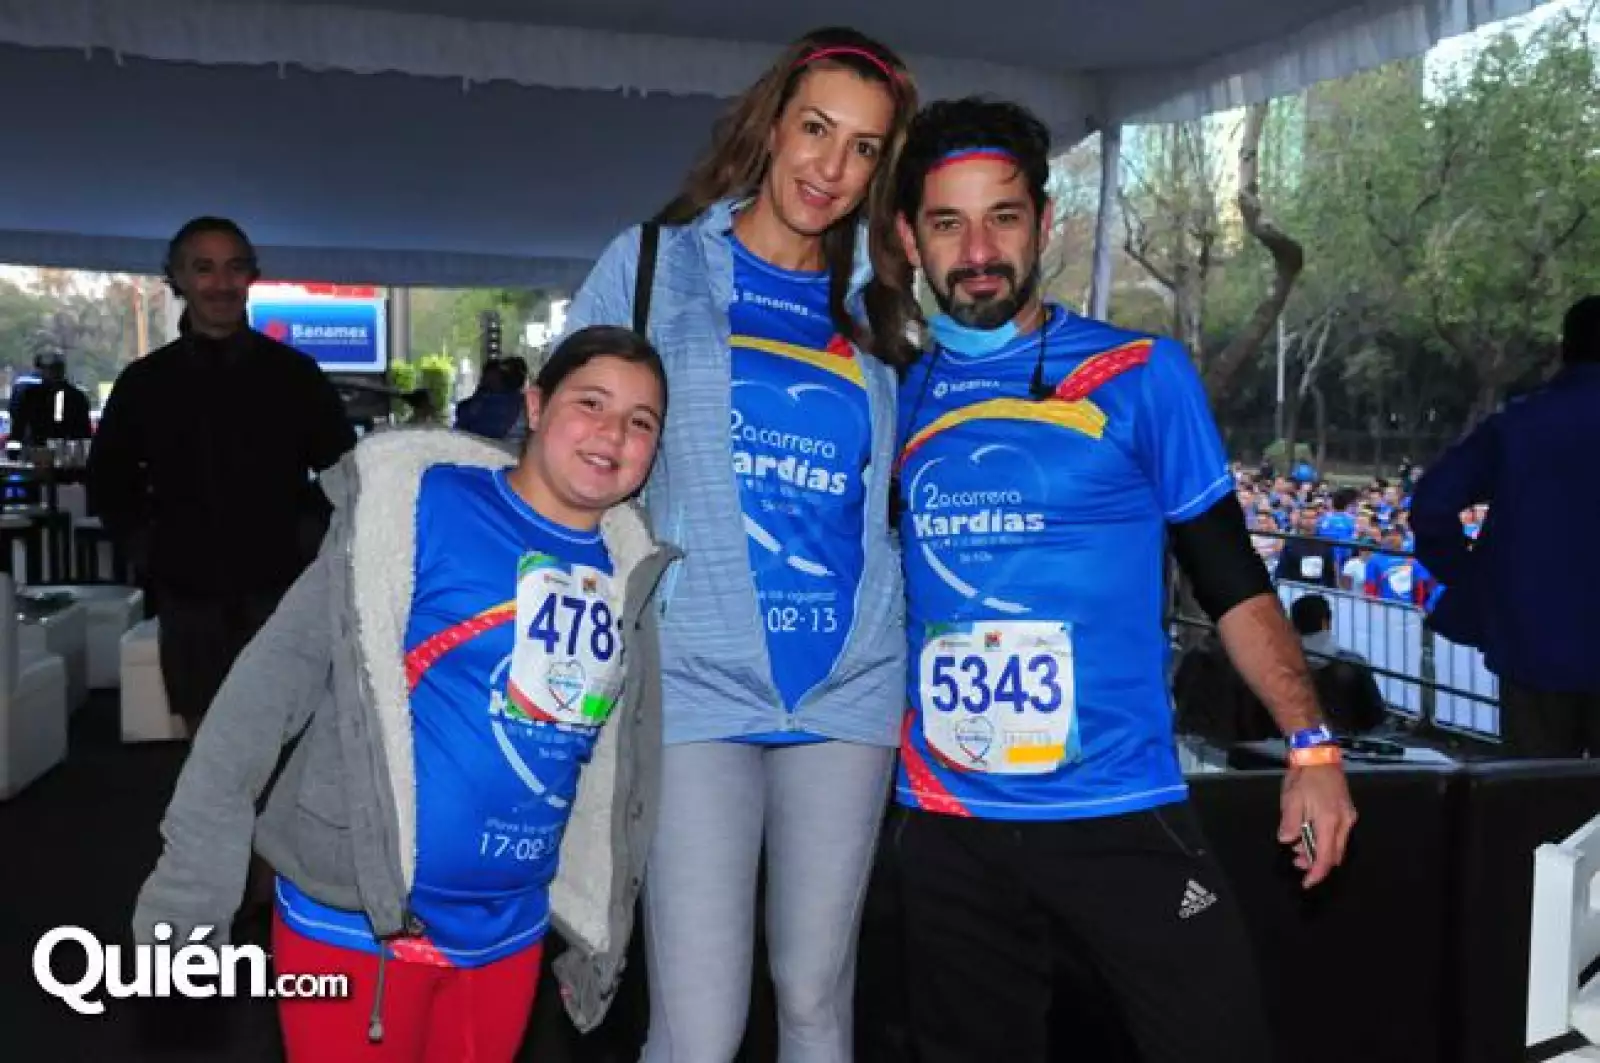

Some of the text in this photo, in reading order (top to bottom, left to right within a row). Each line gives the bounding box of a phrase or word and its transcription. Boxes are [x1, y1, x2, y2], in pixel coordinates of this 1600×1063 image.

[292, 324, 368, 338] Banamex
[760, 428, 836, 459] carrera
[527, 592, 623, 662] 478
[932, 654, 1062, 713] 5343
